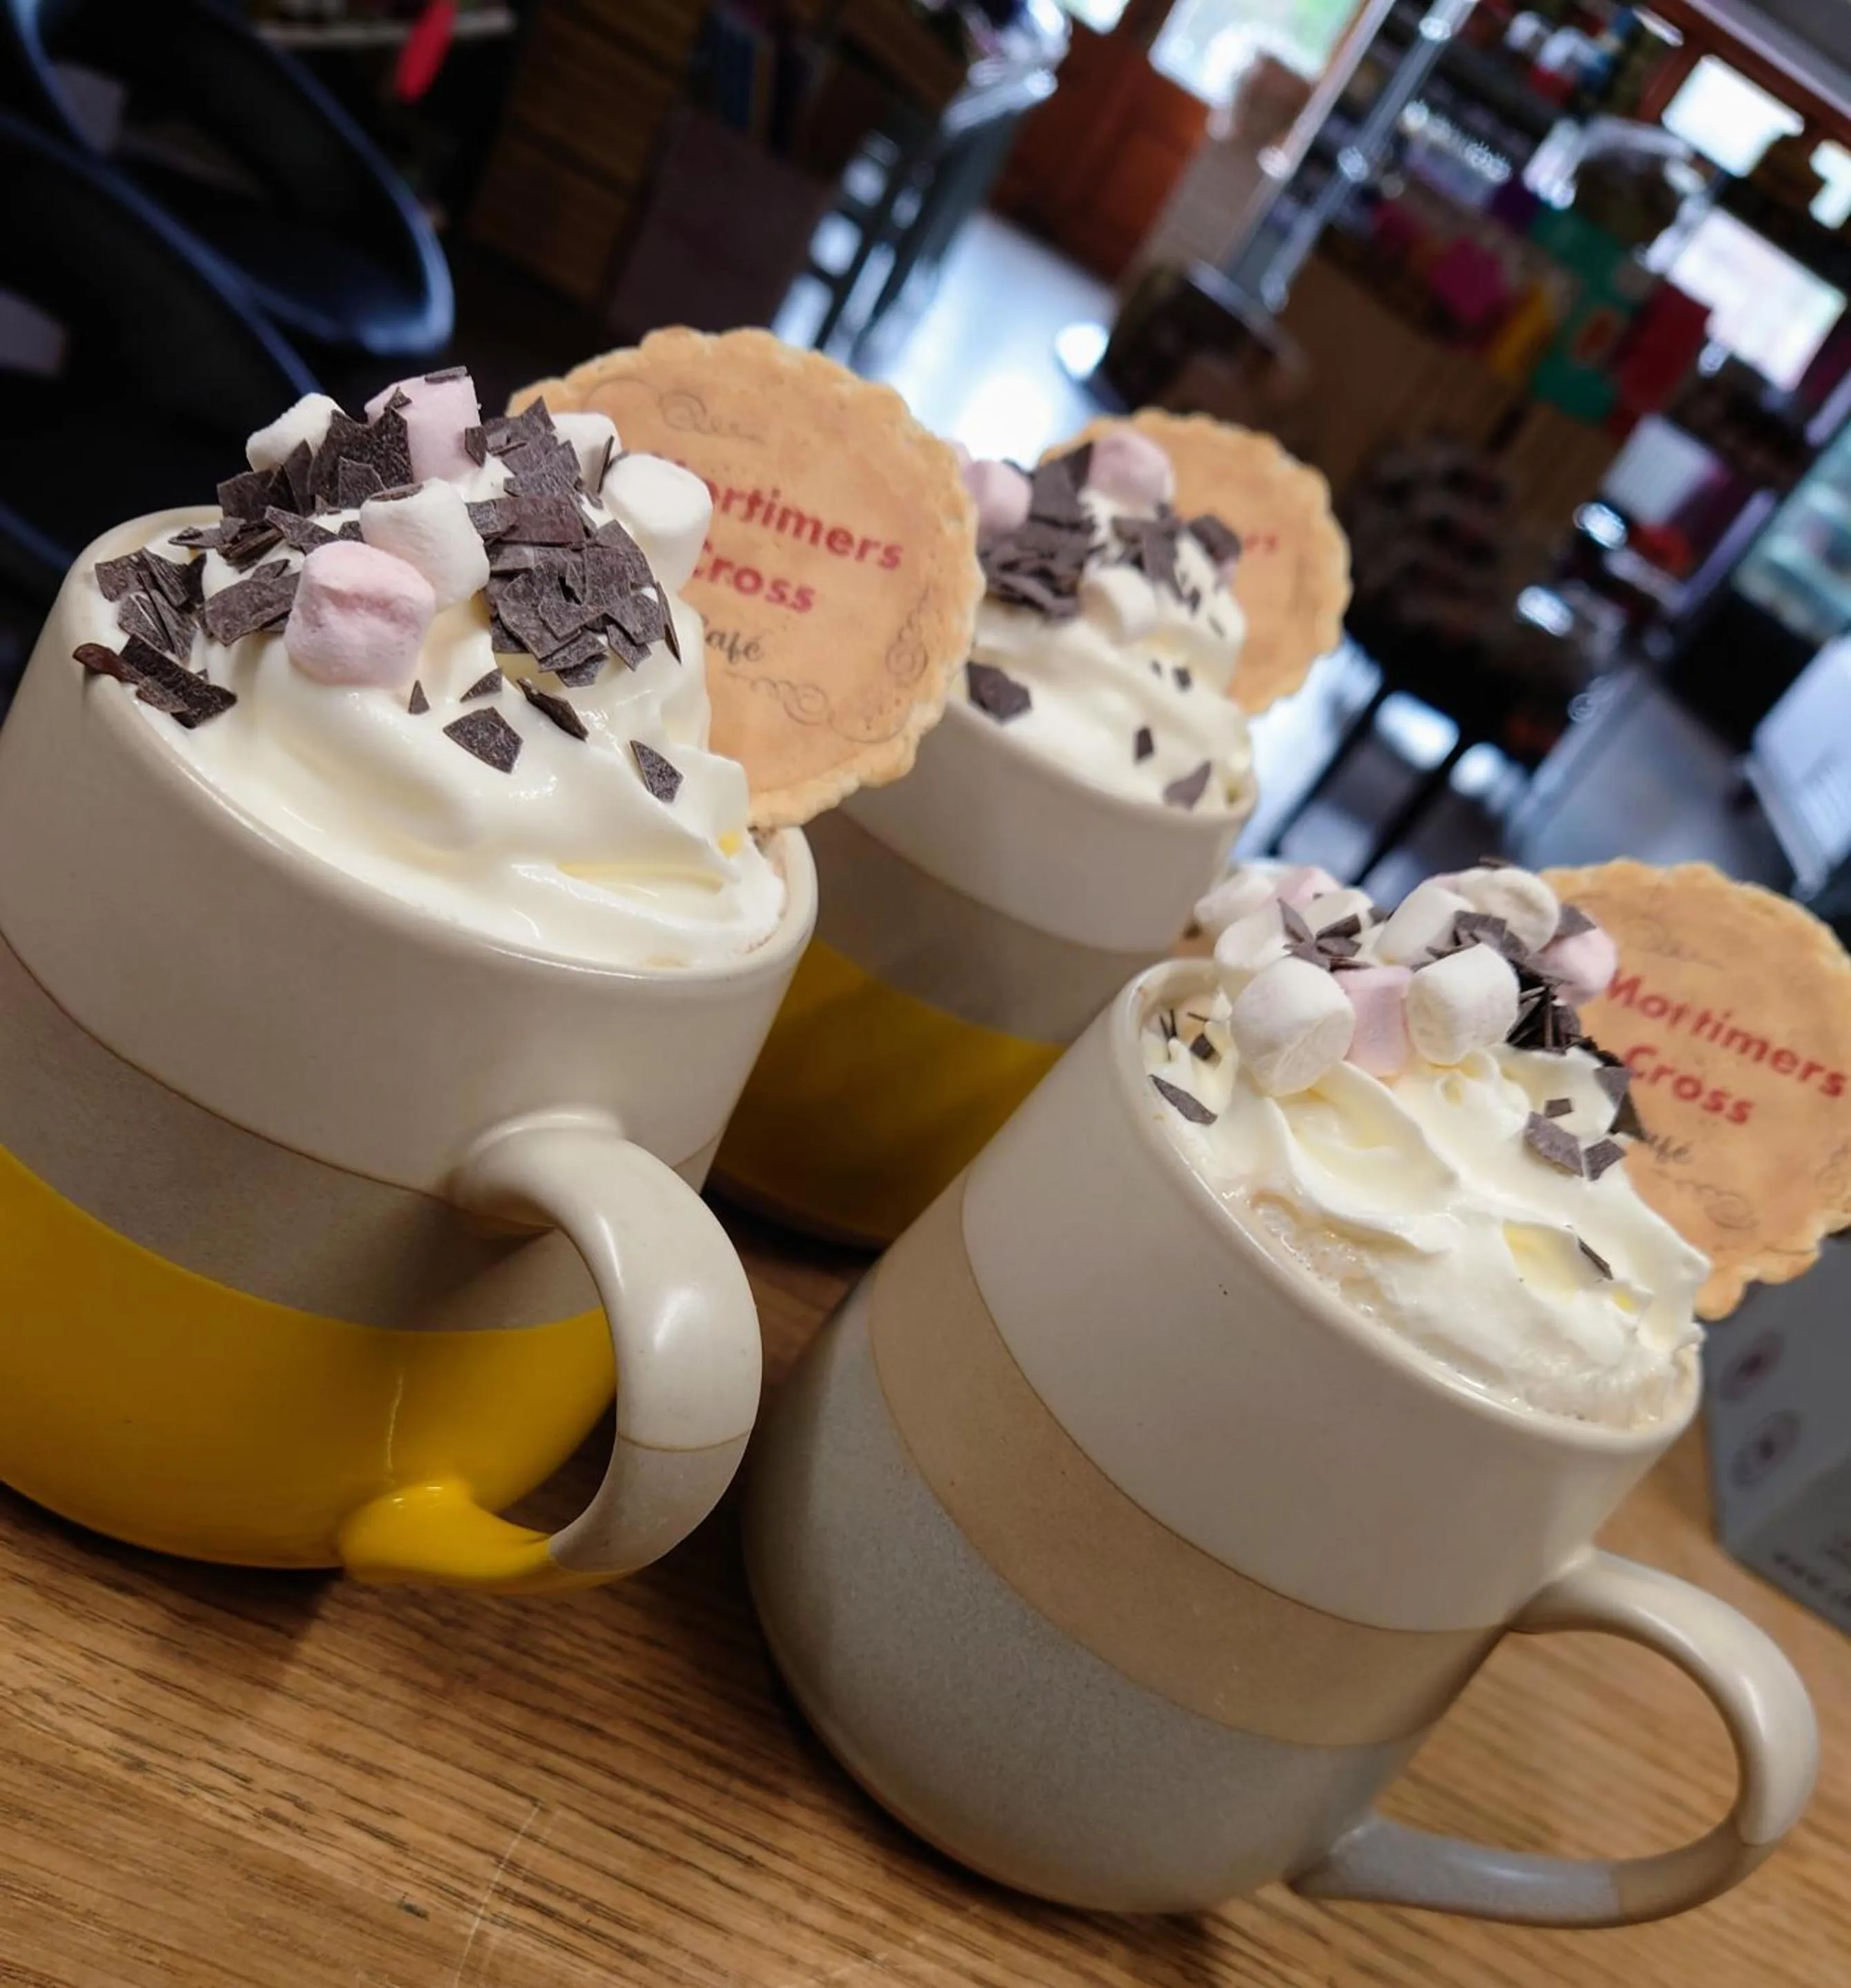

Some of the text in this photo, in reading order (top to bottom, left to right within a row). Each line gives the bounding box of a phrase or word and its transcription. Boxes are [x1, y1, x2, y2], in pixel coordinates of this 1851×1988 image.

[701, 476, 905, 573] rtimers
[692, 537, 817, 615] ross
[700, 613, 766, 665] afé
[1624, 1044, 1754, 1125] Cross
